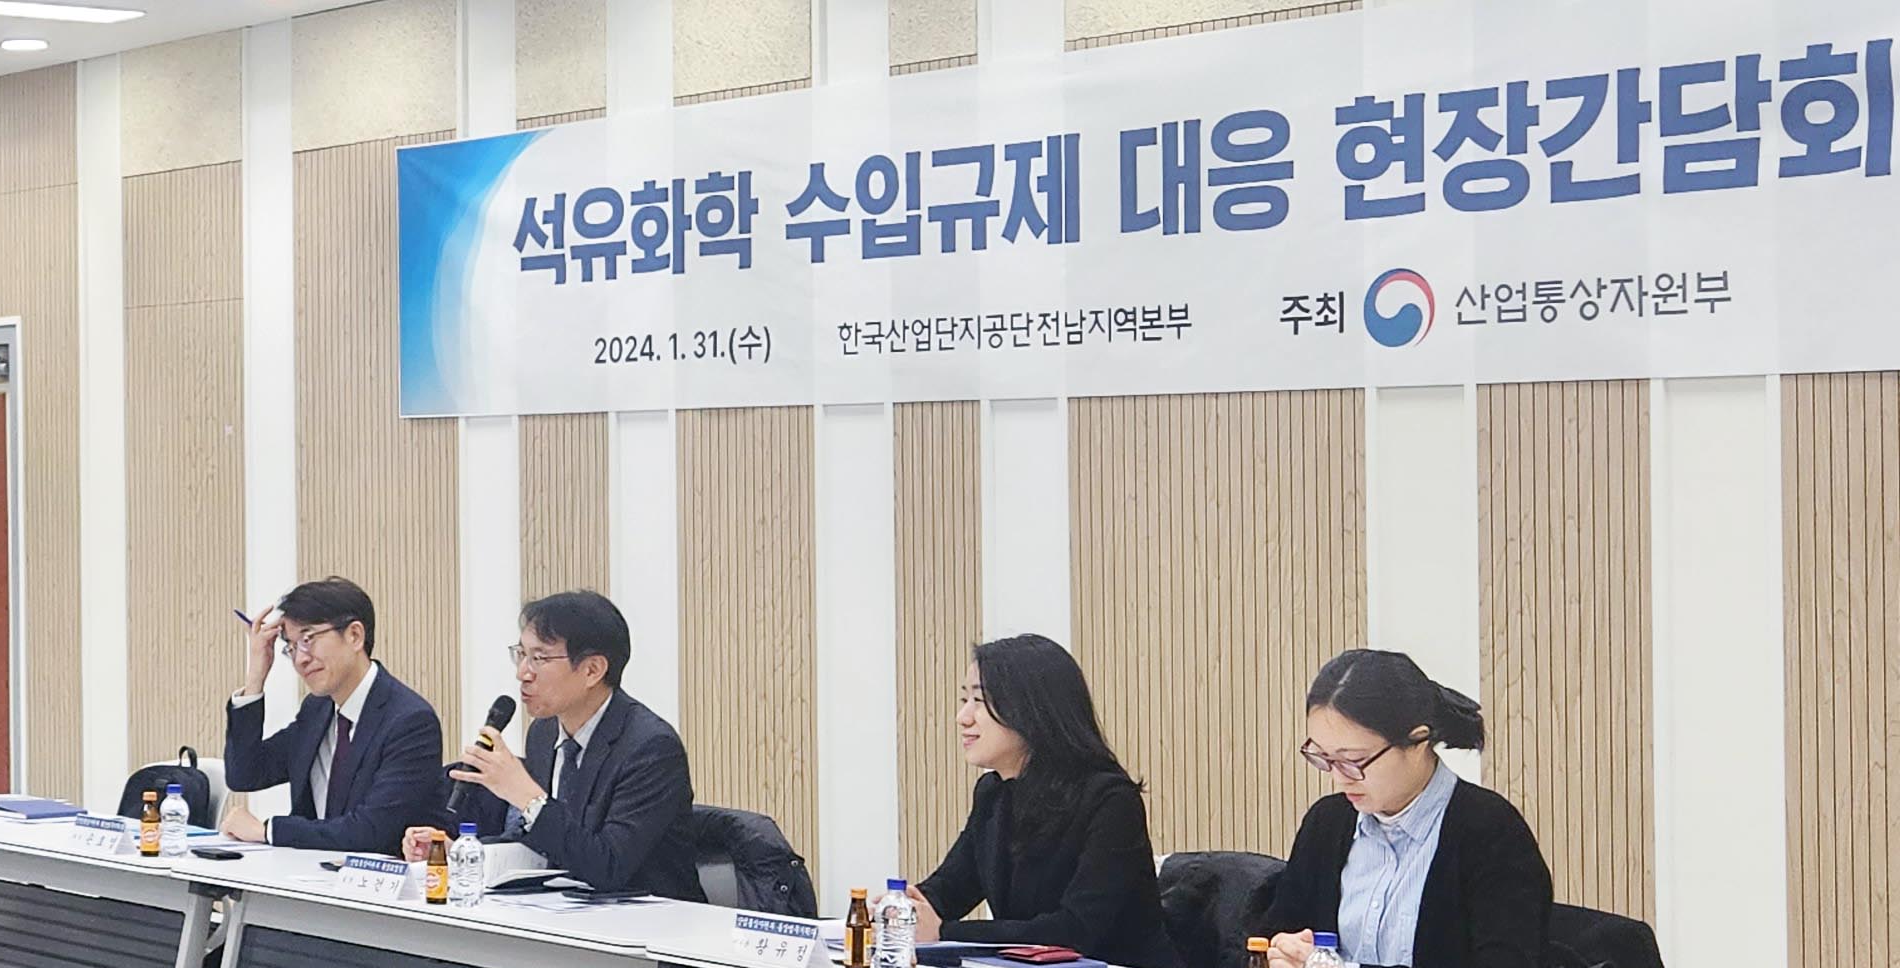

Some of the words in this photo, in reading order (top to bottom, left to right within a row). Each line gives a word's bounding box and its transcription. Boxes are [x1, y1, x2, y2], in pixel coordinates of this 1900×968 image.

[512, 170, 759, 285] 석유화학
[785, 132, 1081, 264] 수입규제
[1119, 109, 1295, 236] 대응
[1334, 38, 1895, 221] 현장간담회
[1279, 290, 1345, 336] 주최
[1455, 270, 1732, 326] 산업통상자원부
[594, 334, 661, 364] 2024.
[668, 332, 686, 361] 1.
[693, 325, 772, 365] 31.(수)
[837, 310, 1033, 356] 한국산업단지공단
[1036, 303, 1193, 347] 전남지역본부
